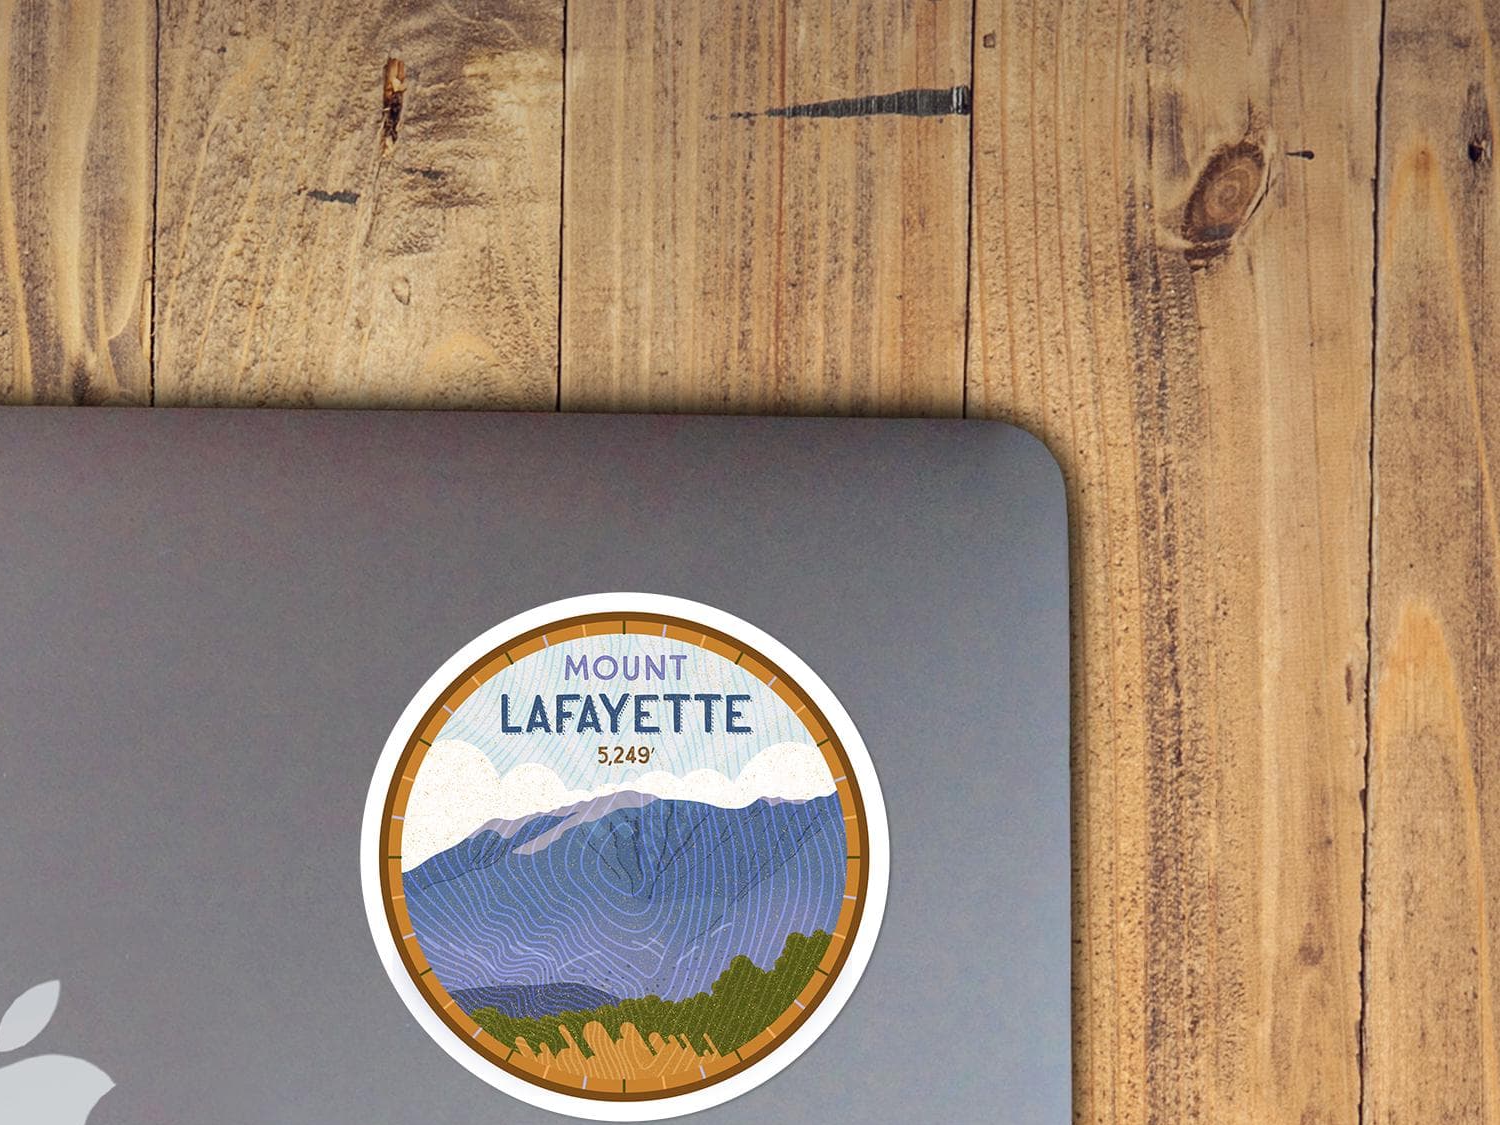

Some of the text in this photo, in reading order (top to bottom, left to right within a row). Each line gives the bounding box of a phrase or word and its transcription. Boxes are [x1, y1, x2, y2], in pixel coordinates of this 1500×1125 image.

[564, 654, 688, 682] MOUNT
[501, 693, 753, 736] LAFAYETTE
[597, 746, 655, 767] 5,249'
